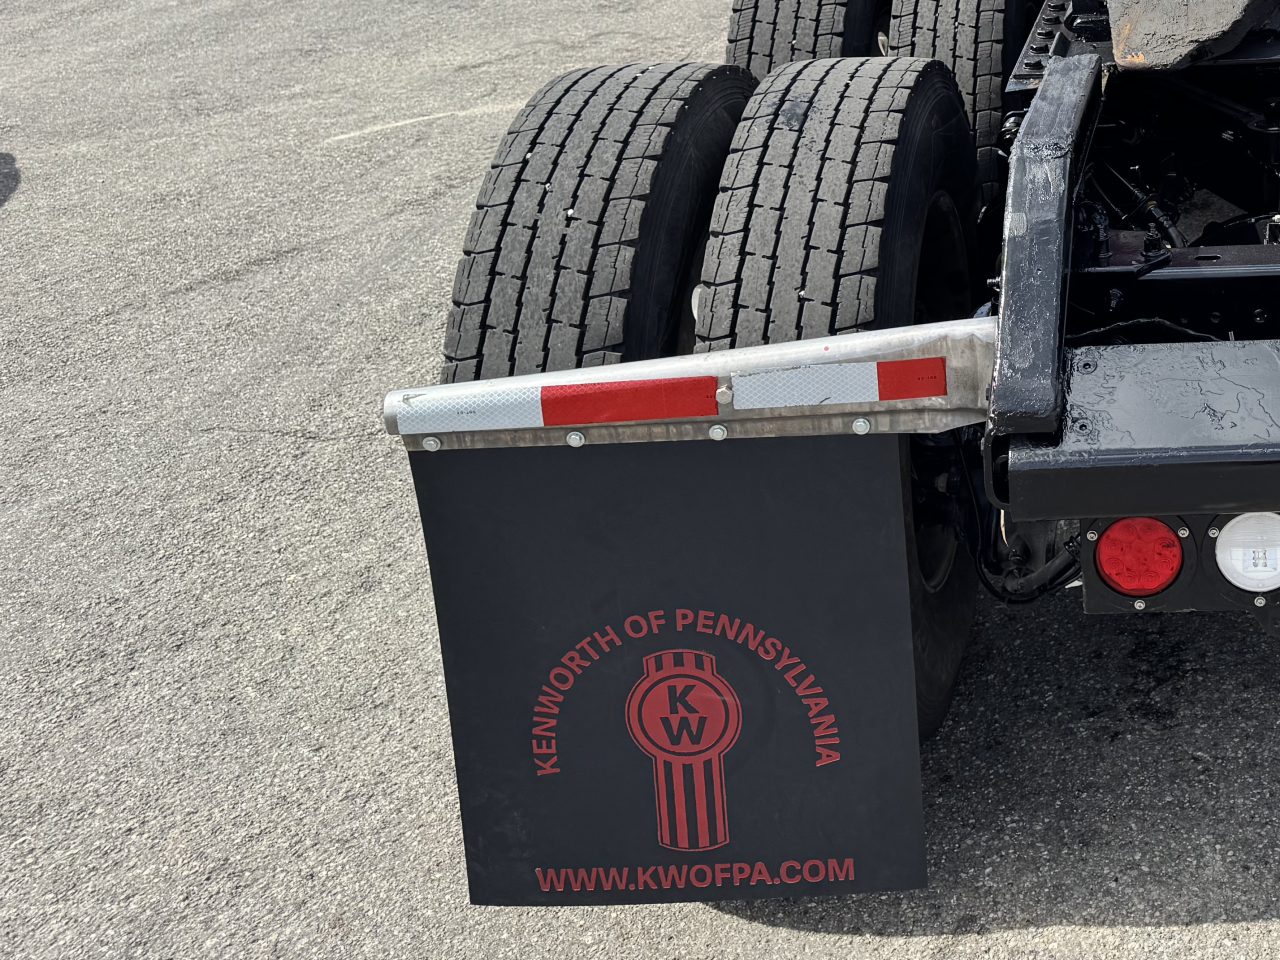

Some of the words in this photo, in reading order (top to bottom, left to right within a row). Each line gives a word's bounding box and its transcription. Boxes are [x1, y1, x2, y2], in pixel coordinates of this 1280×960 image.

[531, 626, 622, 776] KENWORTH
[624, 611, 666, 639] OF
[676, 609, 842, 768] PENNSYLVANIA
[535, 858, 855, 893] WWW.KWOFPA.COM
